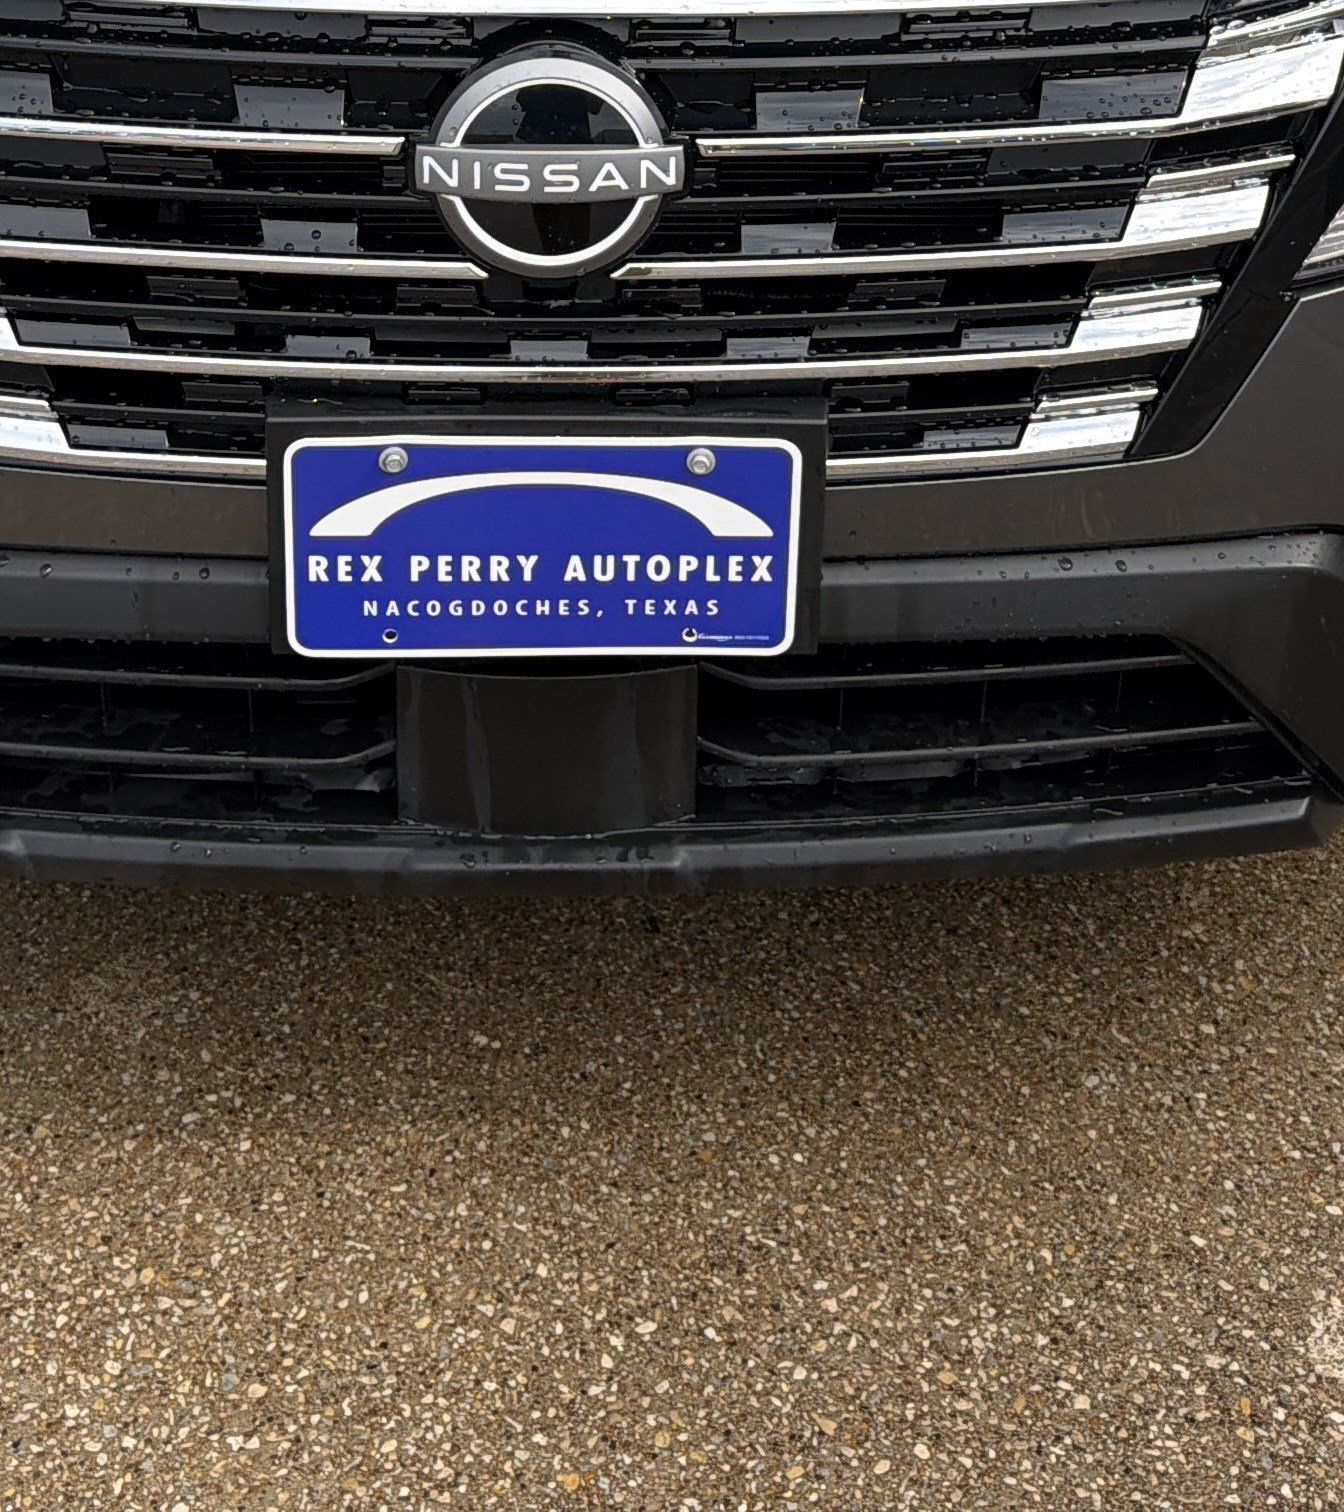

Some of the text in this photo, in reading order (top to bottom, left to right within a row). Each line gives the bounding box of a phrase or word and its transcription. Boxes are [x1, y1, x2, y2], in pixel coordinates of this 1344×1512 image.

[422, 155, 678, 193] NISSAN
[308, 554, 774, 583] REX PERRY AUTOPLEX
[363, 599, 720, 618] NACOGDOCHES, TEXAS
